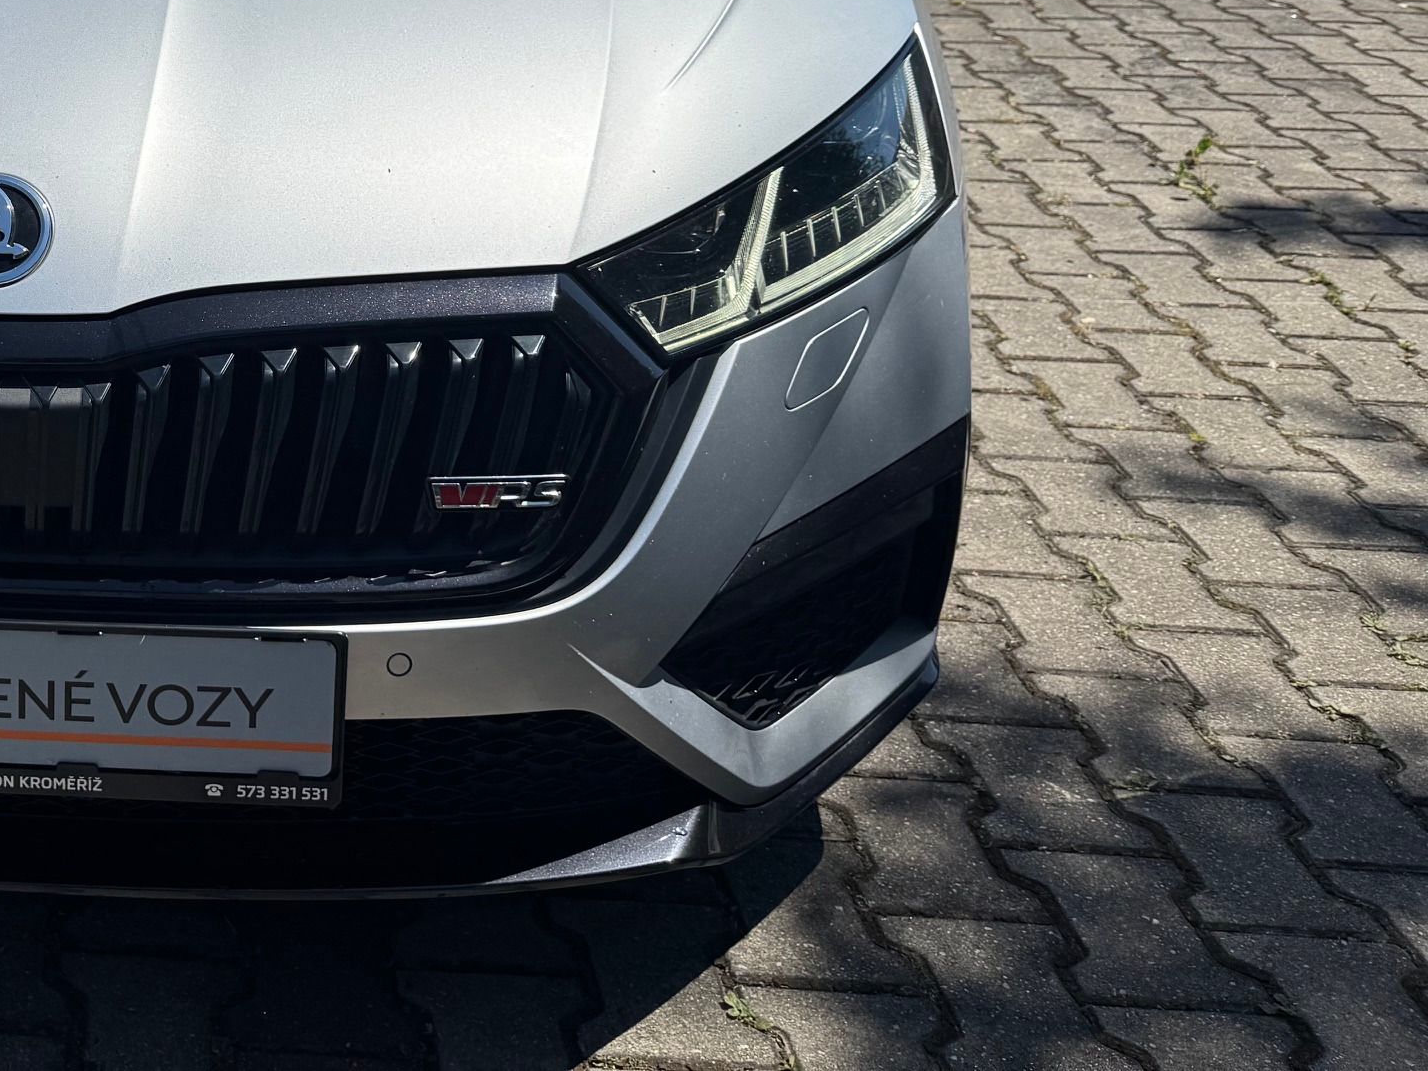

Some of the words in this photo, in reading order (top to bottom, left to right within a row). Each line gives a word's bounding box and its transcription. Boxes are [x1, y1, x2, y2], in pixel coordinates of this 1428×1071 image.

[106, 682, 275, 729] VOZY
[19, 775, 103, 792] KROMĚŘÍŽ
[236, 784, 266, 799] 573
[270, 786, 297, 800] 331
[301, 787, 328, 801] 531
